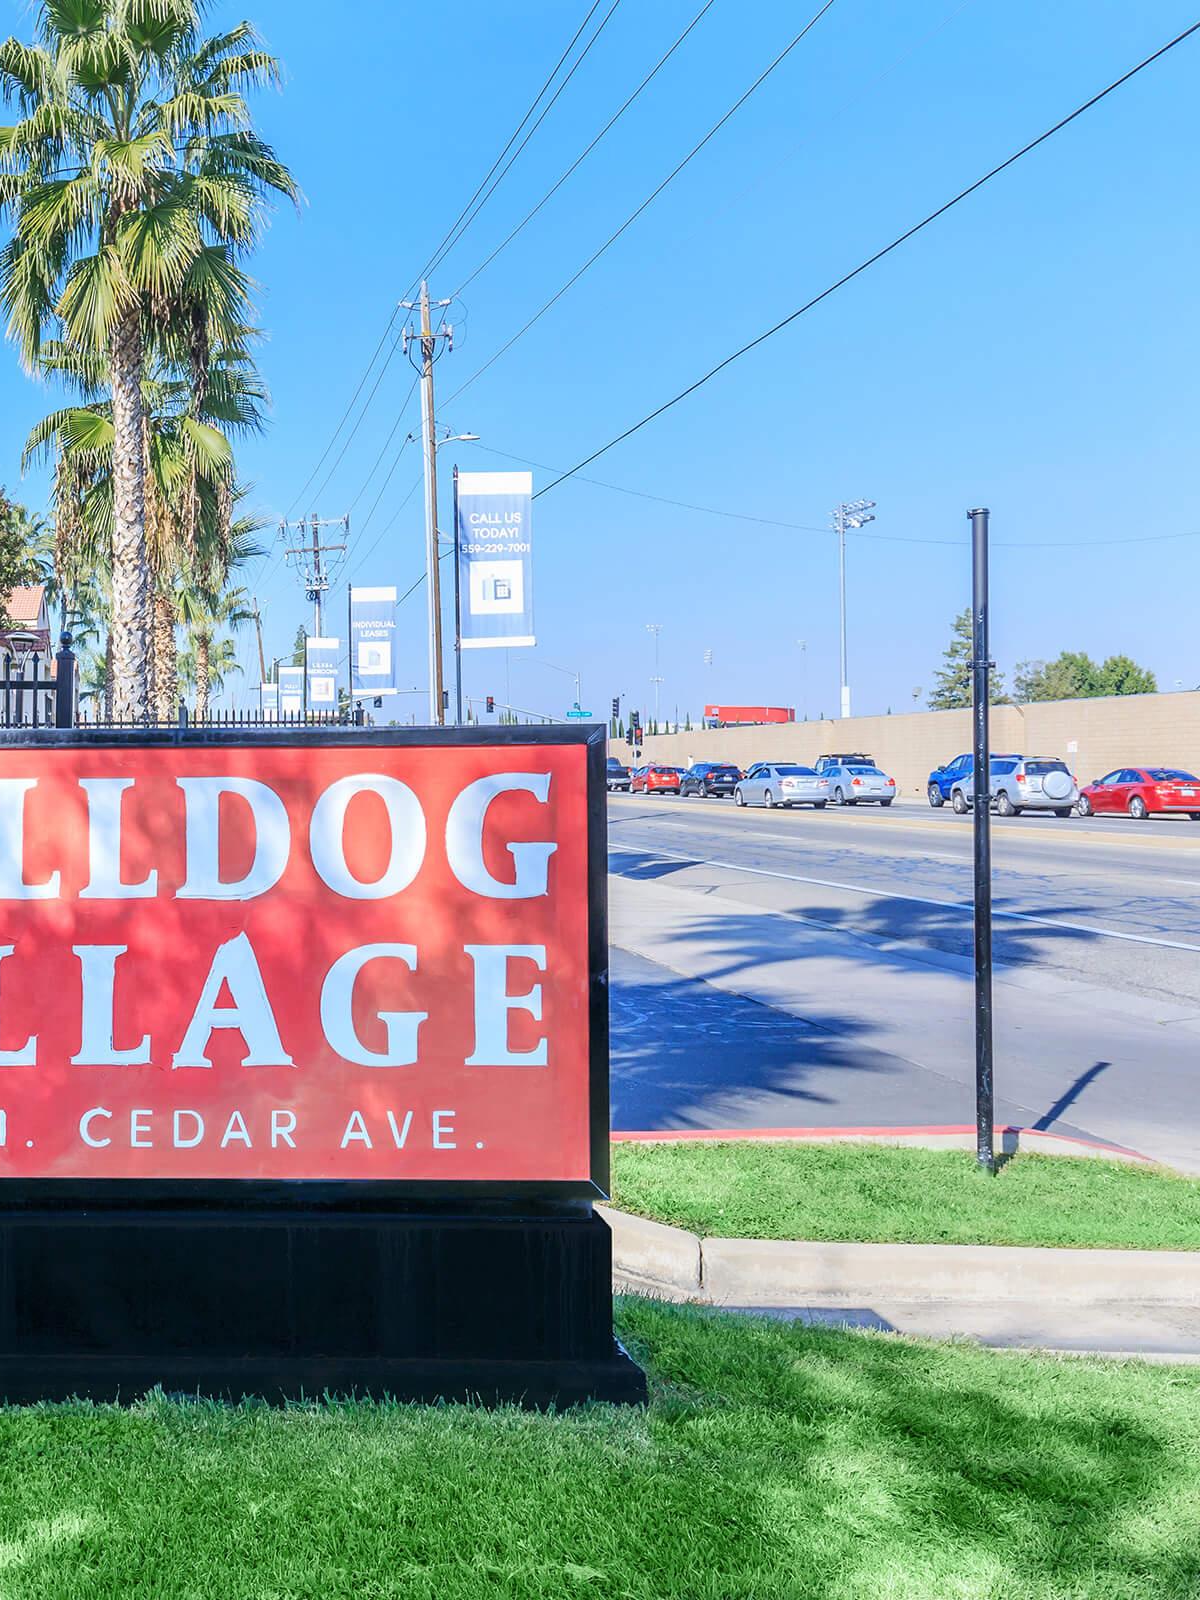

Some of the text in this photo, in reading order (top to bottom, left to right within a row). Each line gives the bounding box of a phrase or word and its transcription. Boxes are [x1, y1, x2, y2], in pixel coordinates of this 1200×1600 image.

[470, 512, 522, 524] CALL US
[473, 527, 519, 539] TODAY!
[462, 543, 531, 553] 559-229-7001
[79, 1106, 298, 1149] CEDAR
[340, 1109, 484, 1150] AVE.
